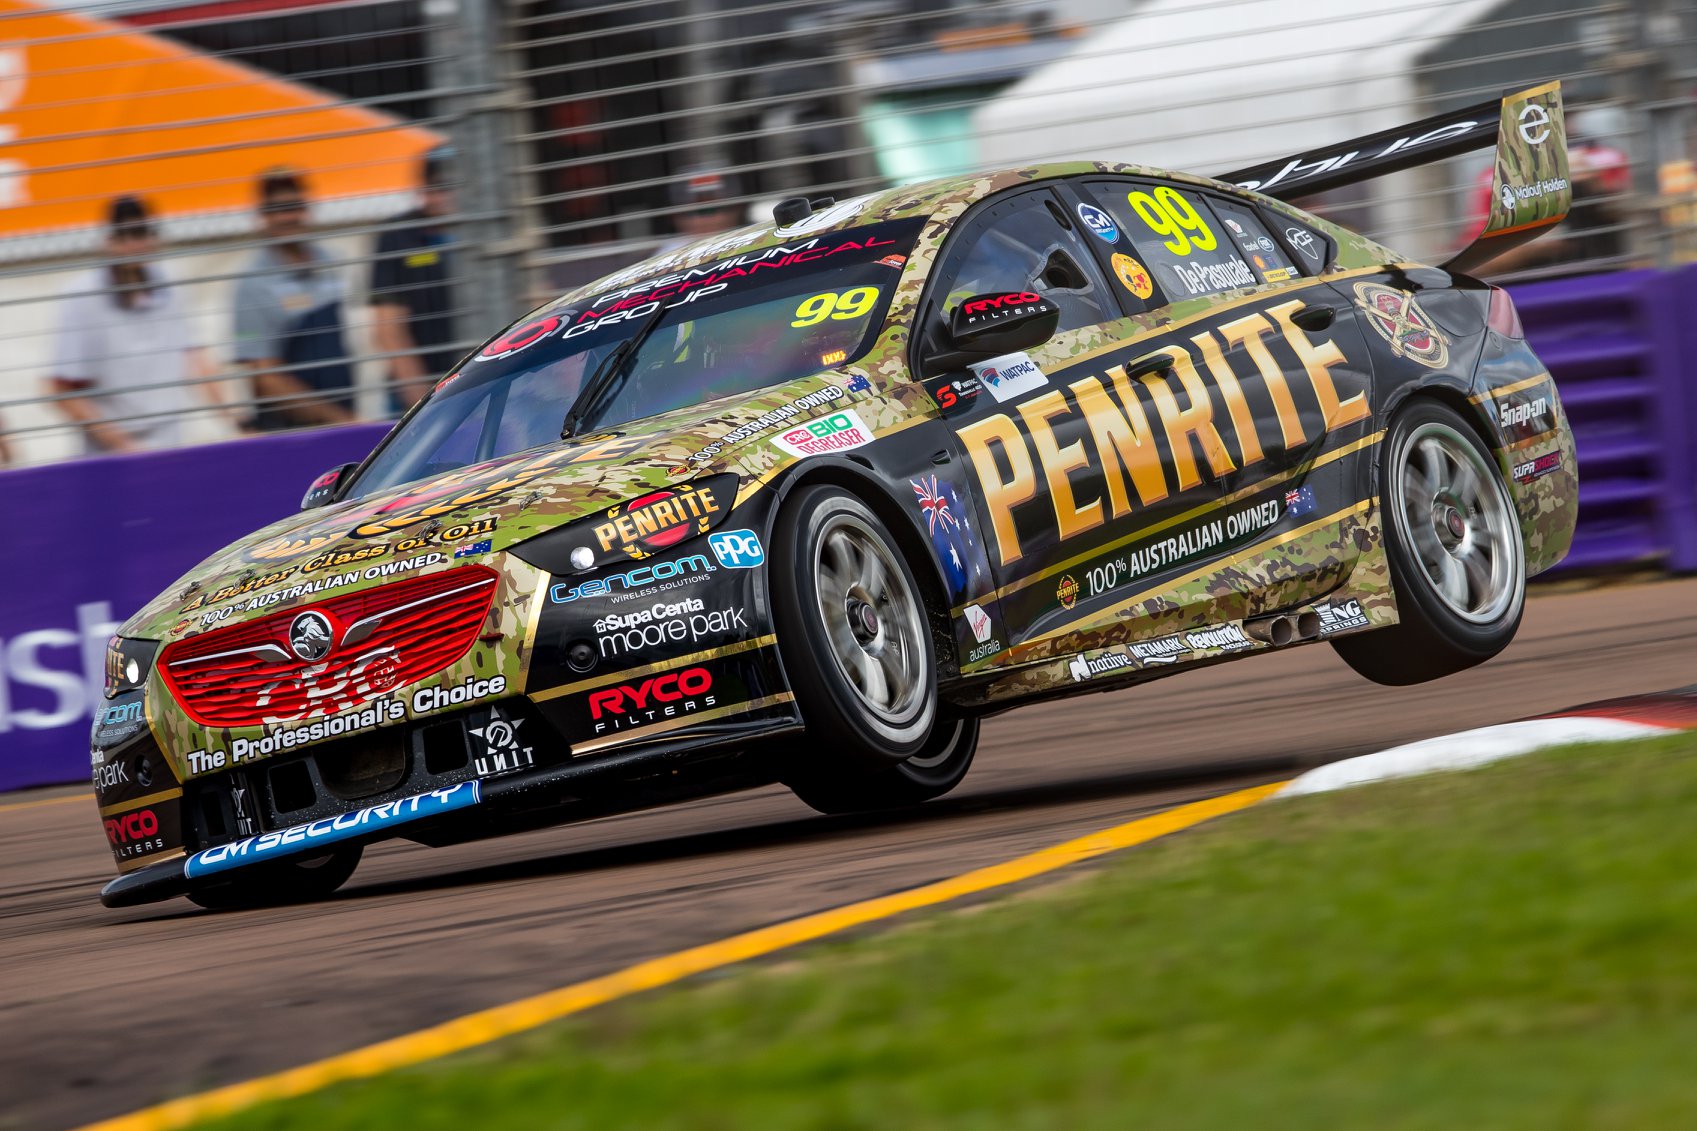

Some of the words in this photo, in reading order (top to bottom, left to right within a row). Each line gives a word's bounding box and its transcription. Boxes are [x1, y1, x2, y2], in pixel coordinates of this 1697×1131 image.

[1515, 181, 1541, 199] Malouf
[1543, 178, 1567, 194] Holden
[1127, 186, 1217, 256] 99
[577, 237, 895, 324] MECHANICAL
[592, 238, 819, 309] PREMIUM
[562, 282, 728, 339] GROUP
[791, 286, 879, 328] 99
[964, 292, 1041, 315] RYCO
[969, 305, 1047, 324] FILTERS
[1000, 361, 1035, 381] WATPAC
[689, 440, 725, 462] 100%
[723, 404, 800, 445] AUSTRALIAN
[794, 385, 844, 411] OWNED
[806, 413, 854, 438] BIO
[1500, 397, 1547, 428] Snap-on
[797, 428, 866, 455] DEGREASER
[955, 299, 1371, 567] PENRITE
[594, 487, 720, 552] PENRITE
[206, 566, 297, 599] Better
[302, 543, 386, 573] Class
[442, 517, 496, 543] Oil
[713, 534, 762, 565] PPG
[1086, 557, 1127, 596] 100%
[1130, 519, 1223, 577] AUSTRALIAN
[1227, 499, 1279, 539] OWNED
[200, 601, 245, 627] 100%
[246, 570, 360, 611] AUSTRALIAN
[364, 552, 442, 580] OWNED
[611, 587, 658, 605] WIRELESS
[659, 574, 711, 592] SOLUTIONS
[1056, 582, 1080, 600] PENRITE
[599, 617, 687, 658] moore
[690, 606, 748, 643] park
[1320, 616, 1367, 634] SPRINGS
[969, 640, 1000, 662] australia
[1088, 653, 1132, 674] natiive
[1129, 637, 1187, 659] METAMARK
[589, 667, 712, 720] RYCO
[188, 748, 226, 775] The
[232, 700, 405, 763] Professional's
[413, 674, 507, 713] Choice
[596, 696, 716, 733] FILTERS
[100, 760, 130, 794] park
[104, 809, 158, 844] RYCO
[200, 838, 255, 865] CM
[256, 784, 463, 852] SECURITY
